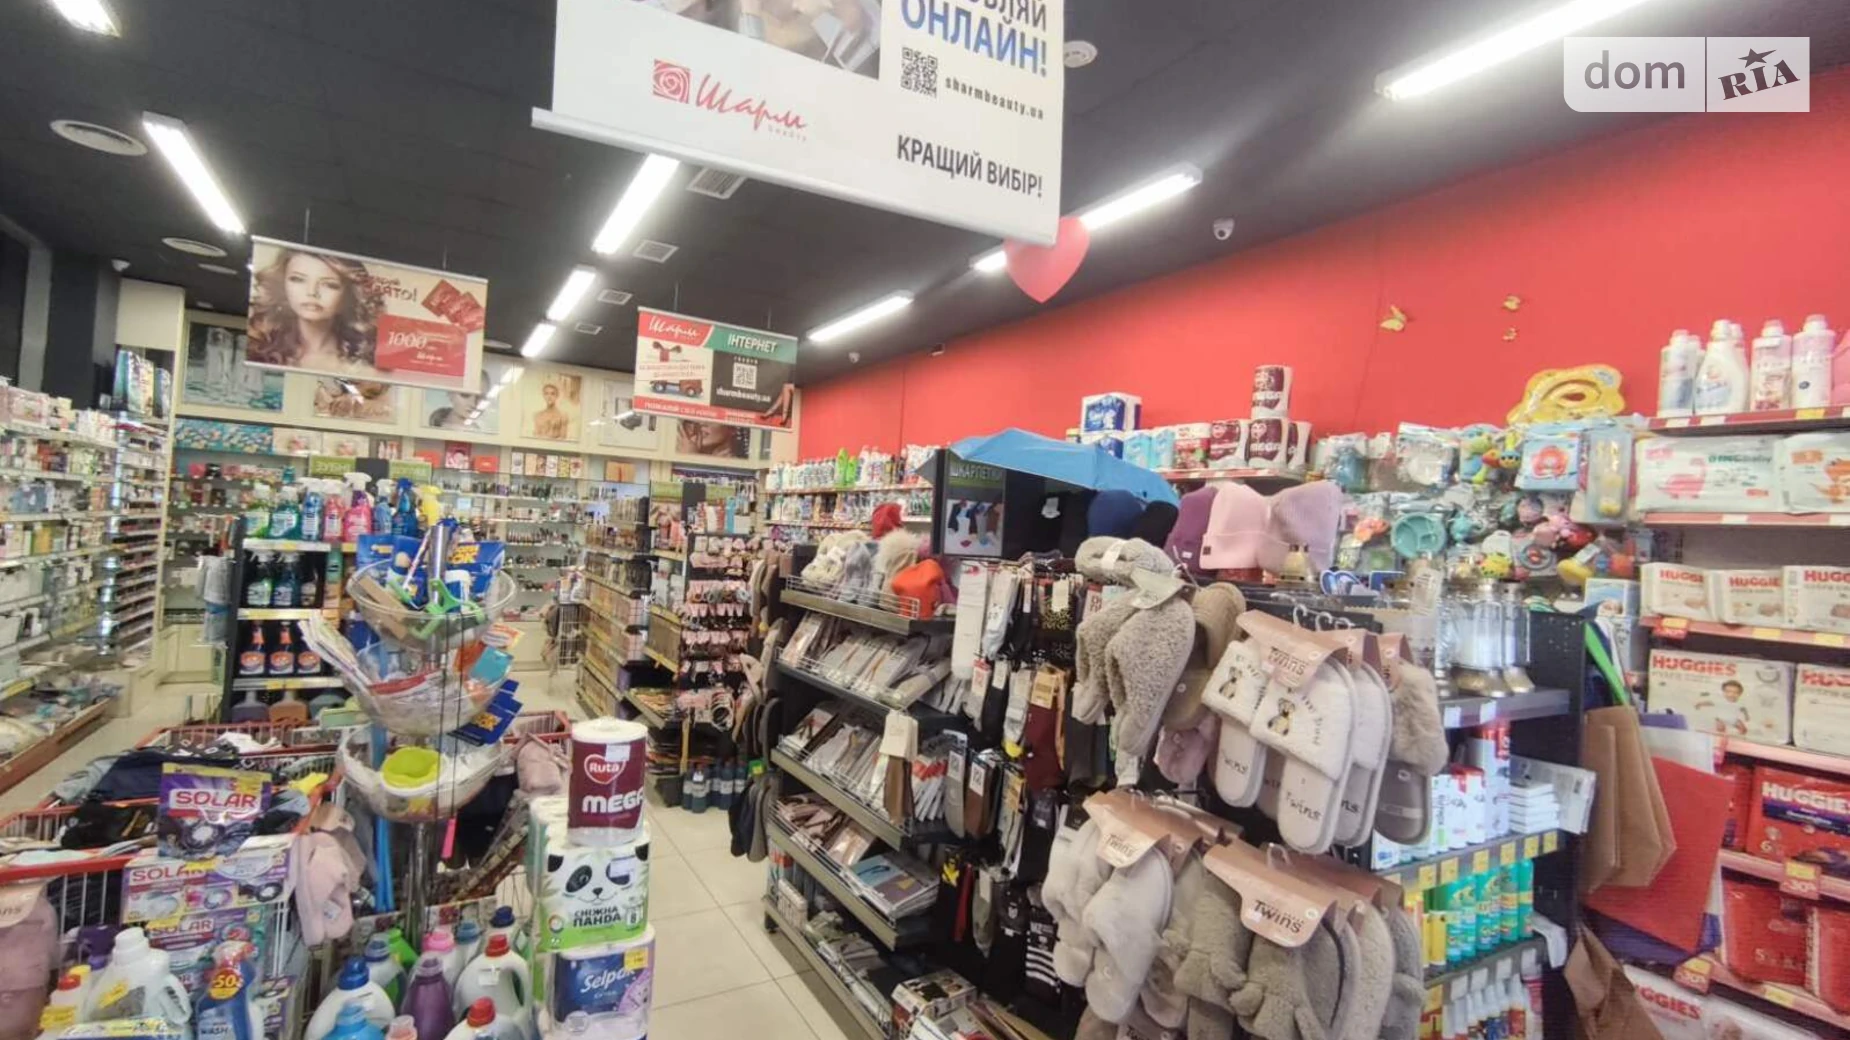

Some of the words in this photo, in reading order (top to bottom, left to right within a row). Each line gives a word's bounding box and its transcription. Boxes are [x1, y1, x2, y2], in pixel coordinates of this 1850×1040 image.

[902, 0, 1047, 77] ОНЛАЙН!
[945, 76, 1044, 120] sharmbeauty.ua
[897, 134, 982, 180] КРАЩИЙ
[987, 159, 1043, 198] ВИБІР!
[387, 331, 427, 349] 1000
[728, 334, 778, 353] ІНТЕРНЕТ
[1652, 655, 1737, 676] HUGGIES
[589, 762, 620, 773] Ruta
[176, 790, 256, 809] SOLAR
[574, 906, 619, 917] СНІЖНА
[1253, 899, 1303, 934] Twins
